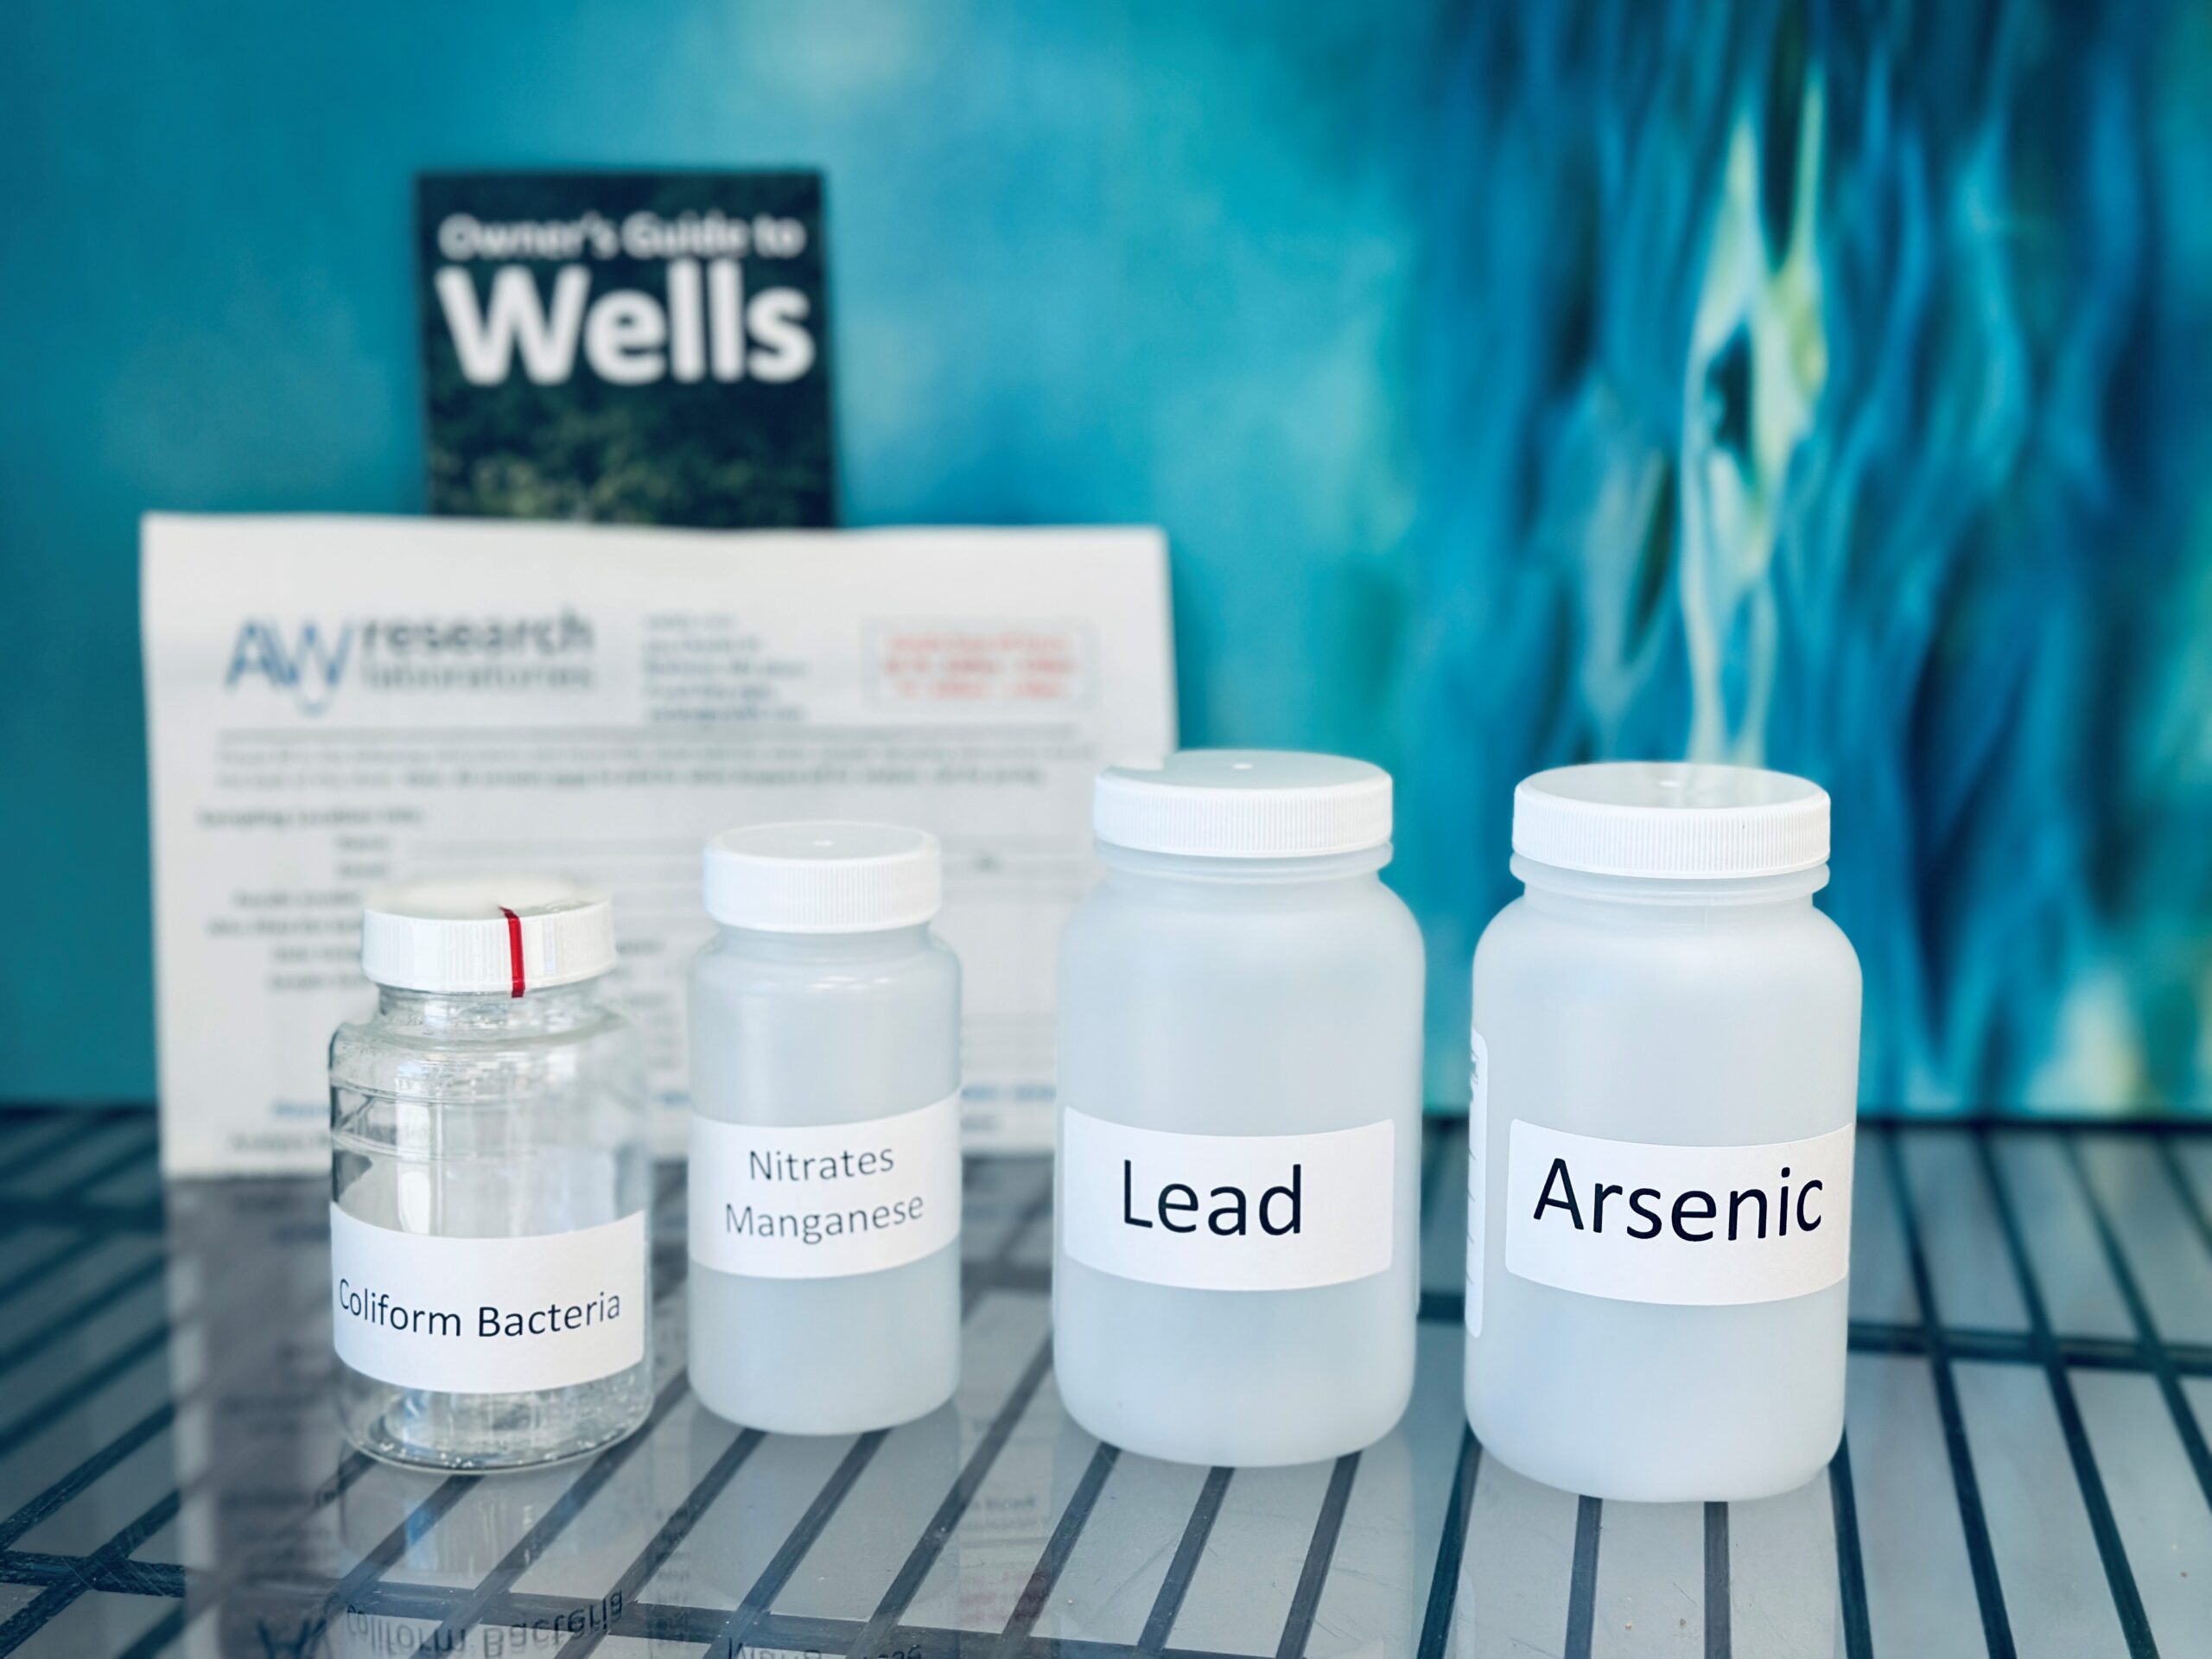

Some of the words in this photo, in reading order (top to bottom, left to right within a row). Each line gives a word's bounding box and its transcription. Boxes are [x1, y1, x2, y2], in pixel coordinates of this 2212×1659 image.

[438, 211, 617, 259] Owner's
[622, 210, 751, 259] Guide
[753, 213, 806, 258] to
[435, 257, 815, 387] Wells
[362, 608, 594, 654] research
[749, 1148, 894, 1182] Nitrates
[726, 1195, 924, 1245] Manganese
[1123, 1159, 1302, 1236] Lead
[1533, 1157, 1824, 1243] Arsenic
[339, 1278, 461, 1337] Coliform
[478, 1291, 620, 1338] Bacteria
